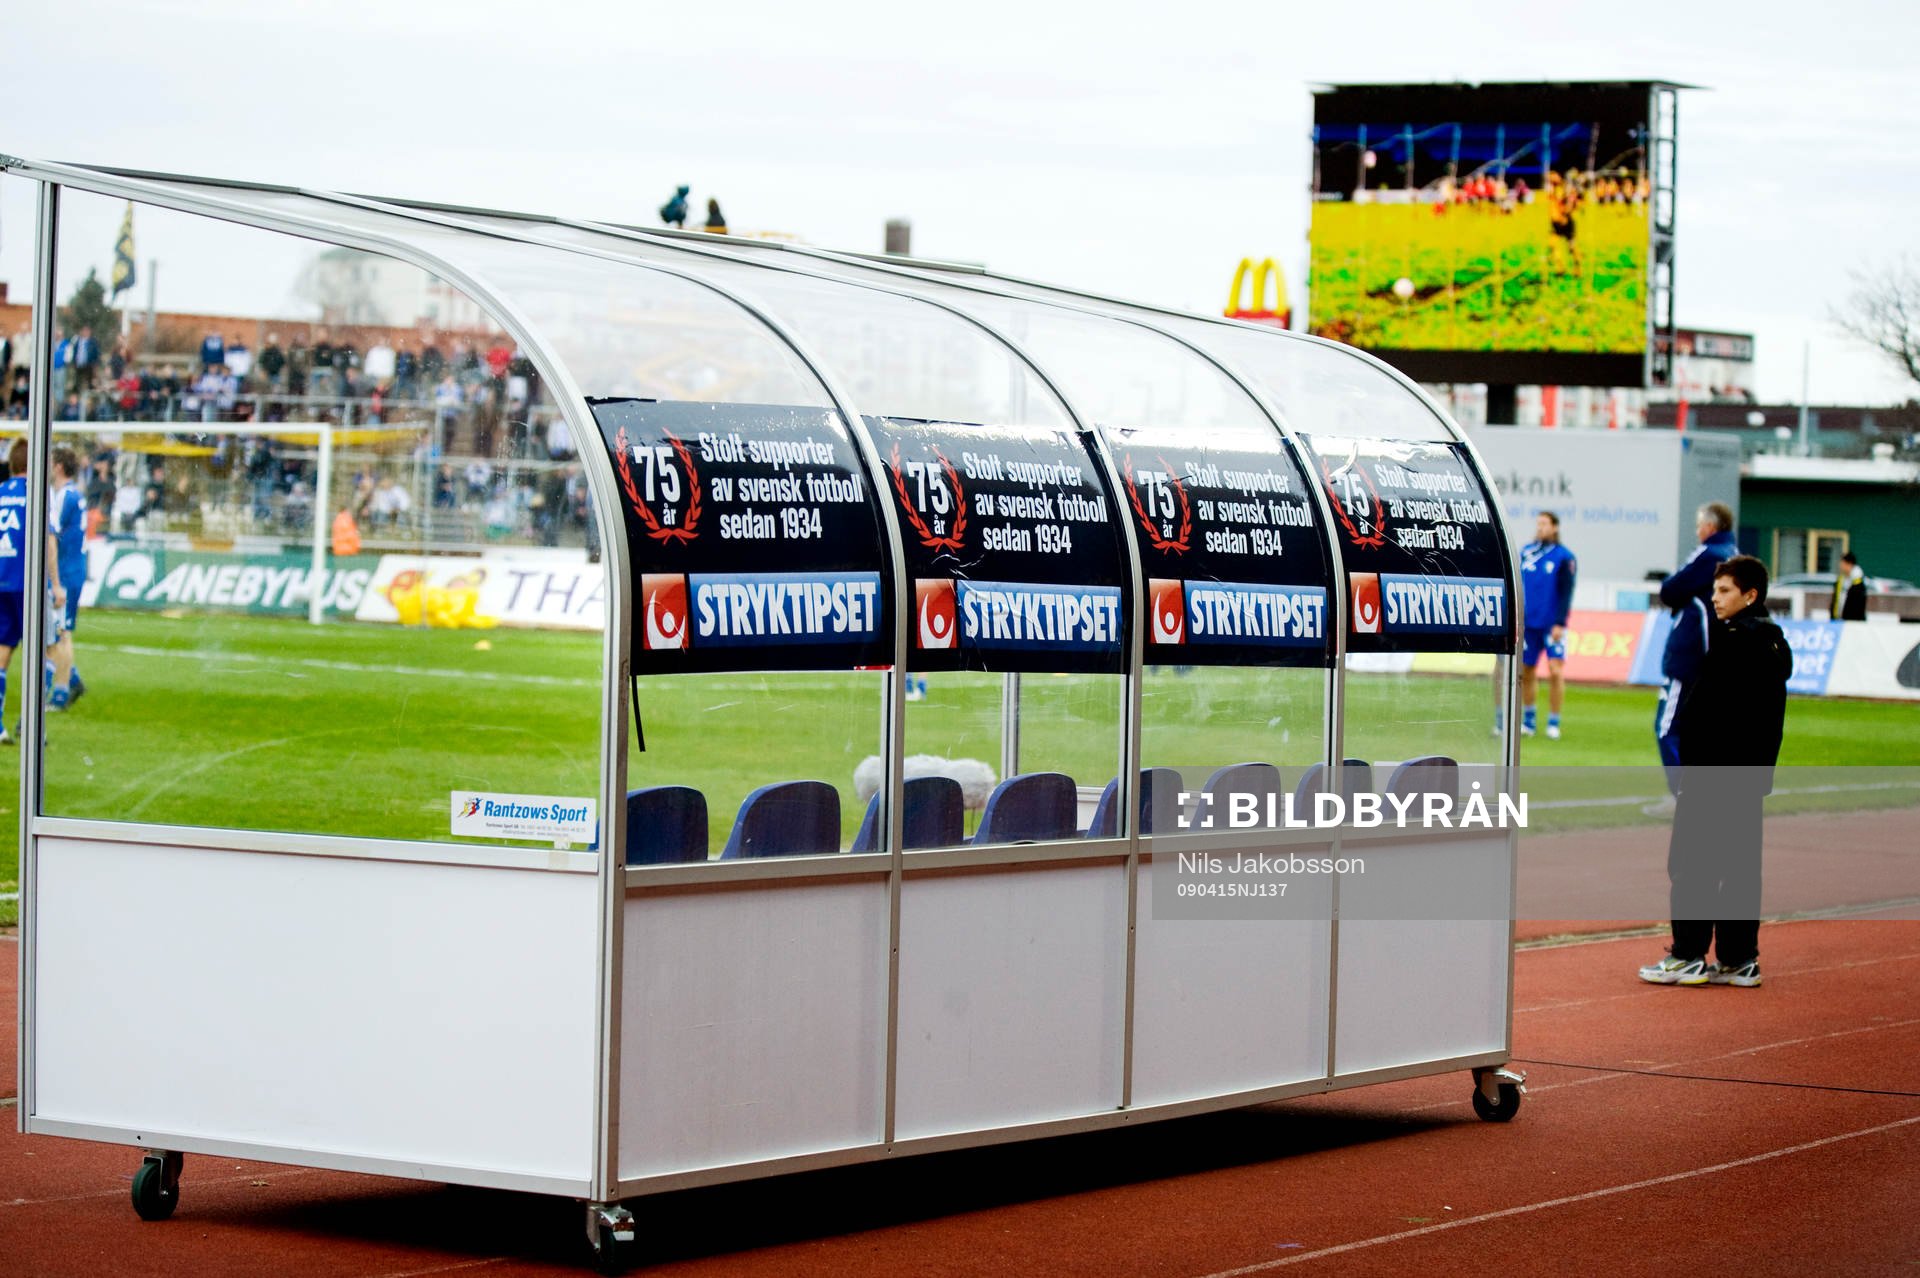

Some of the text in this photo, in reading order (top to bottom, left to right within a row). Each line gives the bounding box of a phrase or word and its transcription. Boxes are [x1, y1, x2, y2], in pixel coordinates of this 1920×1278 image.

[699, 432, 834, 471] Stolt supporter
[633, 446, 681, 503] 75
[962, 451, 1082, 490] Stolt supporter
[1184, 461, 1290, 497] Stolt supporter
[1375, 463, 1467, 496] Stolt supporter
[712, 473, 865, 503] av svensk fotboll
[906, 461, 950, 515] 75
[1137, 470, 1176, 520] 75
[1337, 473, 1370, 517] 75
[662, 503, 676, 525] år
[720, 508, 823, 539] sedan 1934
[975, 493, 1108, 523] av svensk fotboll
[1197, 499, 1313, 528] av svensk fotboll
[1389, 498, 1490, 524] av svensk fotboll
[934, 515, 945, 535] år
[983, 522, 1072, 554] sedan 1934
[1162, 519, 1173, 539] år
[1397, 525, 1465, 550] sedan 1934
[1205, 527, 1282, 556] sedan 1934
[697, 581, 877, 637] STRYKTIPSET
[962, 591, 1118, 642] STRYKTIPSET
[1190, 589, 1324, 639] STRYKTIPSET
[1386, 582, 1503, 627] STRYKTIPSET
[484, 800, 588, 824] Rantzows Sport
